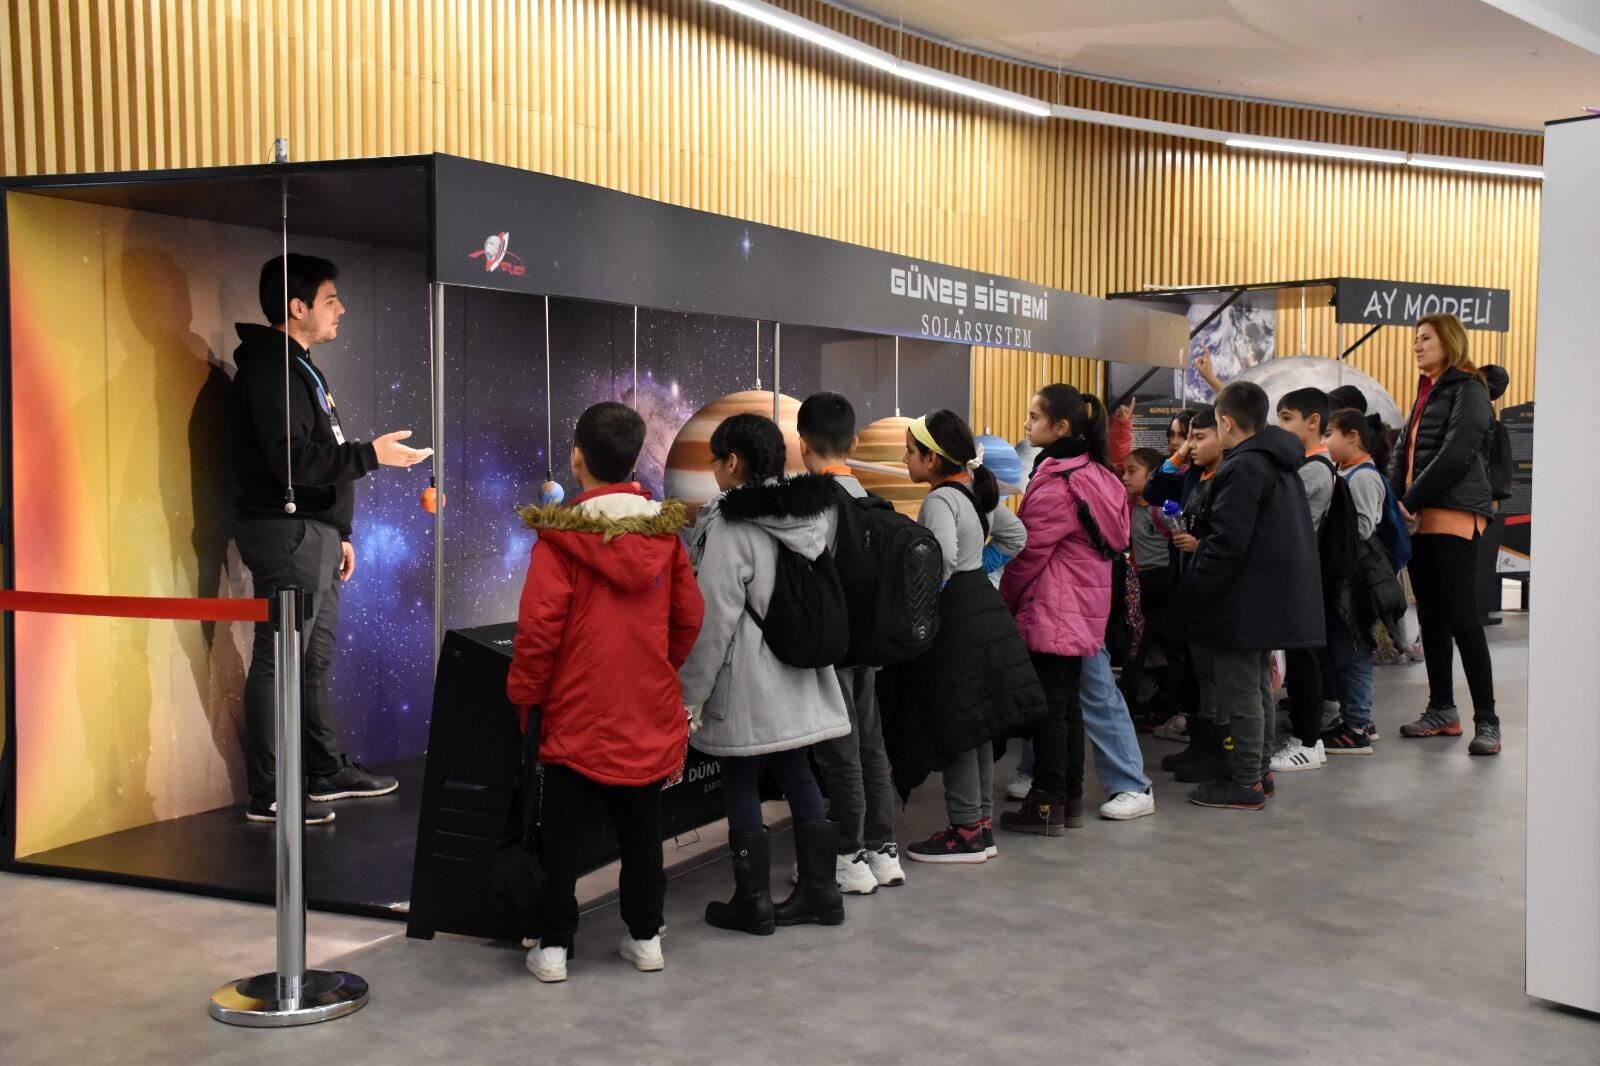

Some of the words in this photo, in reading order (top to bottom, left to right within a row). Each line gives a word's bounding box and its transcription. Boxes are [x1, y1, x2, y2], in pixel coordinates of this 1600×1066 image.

[890, 264, 968, 315] GÜNEŞ
[974, 279, 1048, 321] SİSTEMİ
[1363, 287, 1398, 320] AY
[1404, 291, 1492, 325] MODELİ
[921, 314, 1032, 348] SOLARSYSTEM
[688, 760, 721, 782] DÜNY
